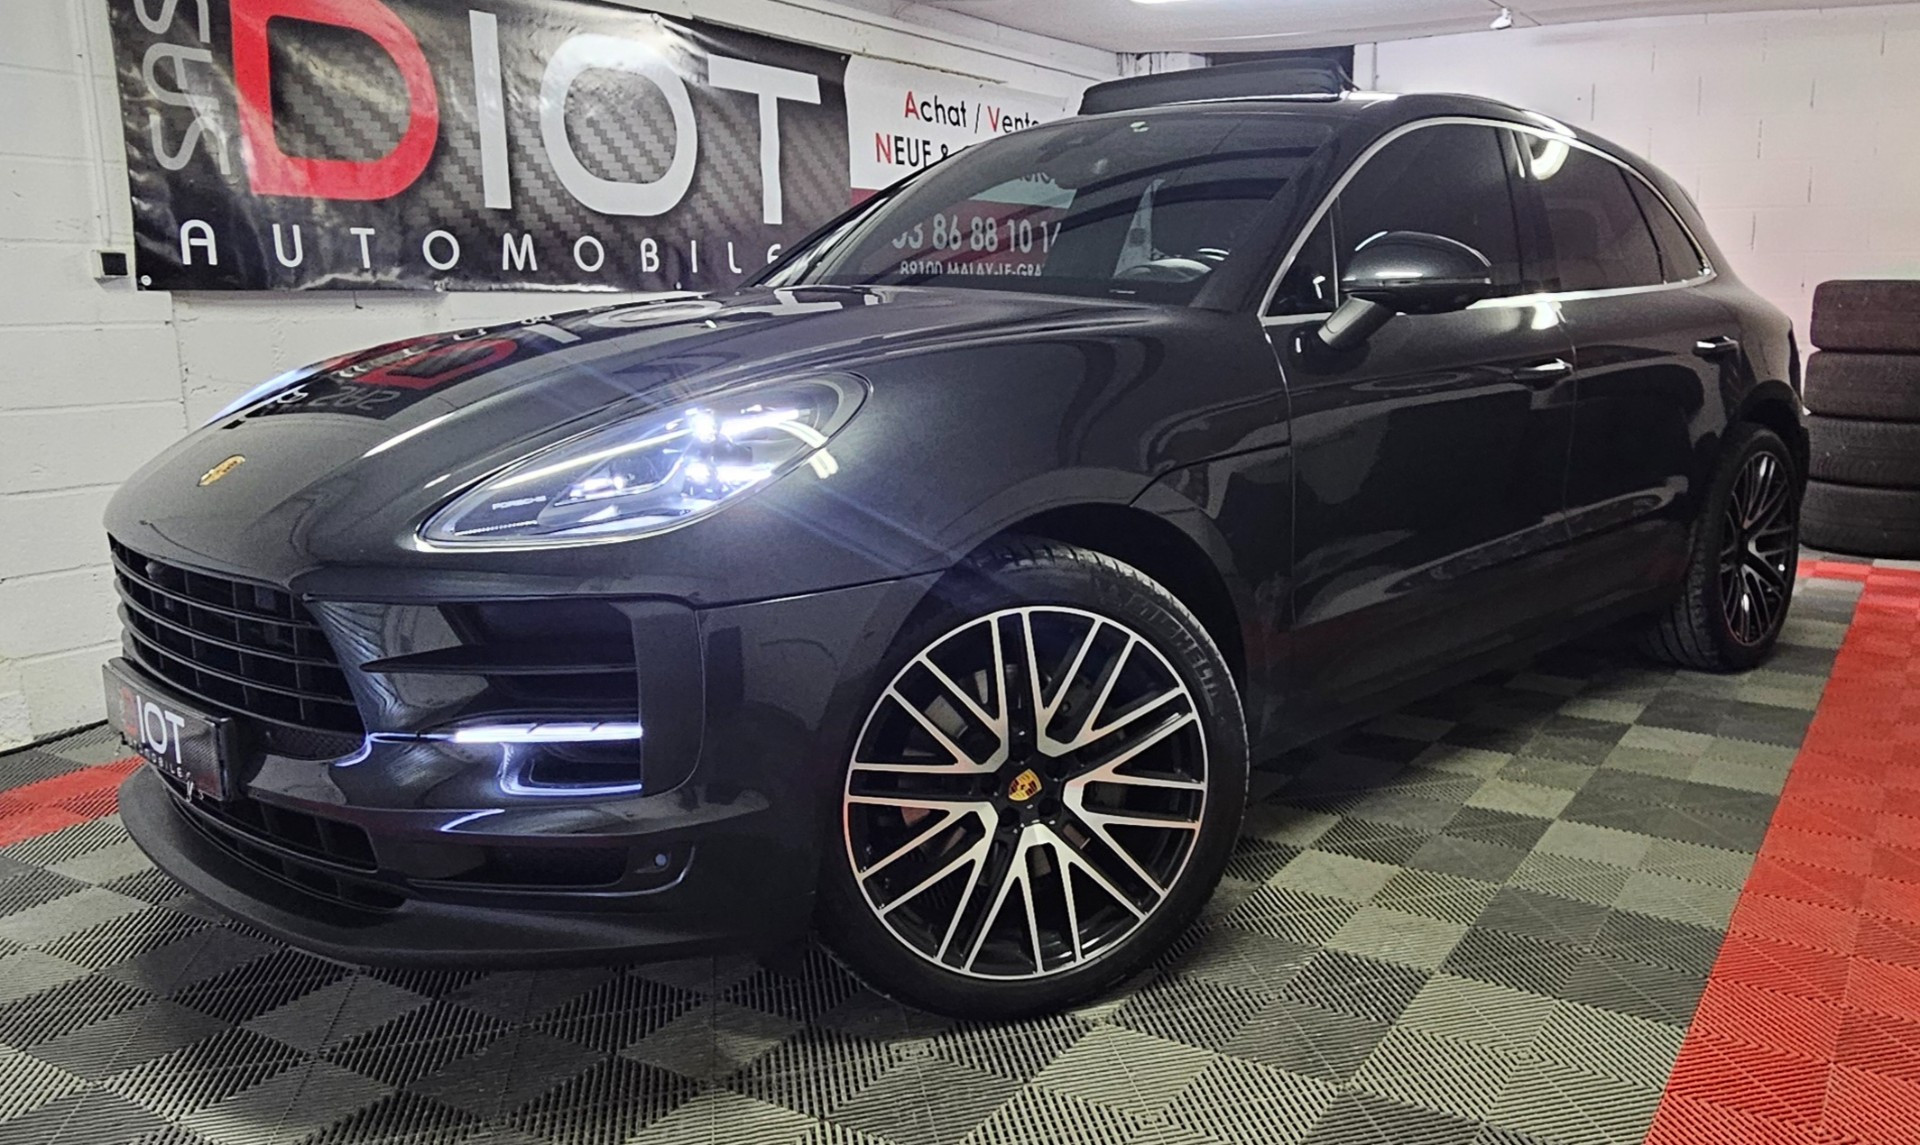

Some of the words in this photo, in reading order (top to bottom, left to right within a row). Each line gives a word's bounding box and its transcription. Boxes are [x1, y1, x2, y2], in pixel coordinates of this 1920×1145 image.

[229, 0, 822, 225] DIOT
[904, 90, 967, 128] Achat
[875, 132, 932, 168] NEUF
[932, 213, 962, 251] 86
[970, 216, 998, 252] 88
[1007, 218, 1033, 254] 10
